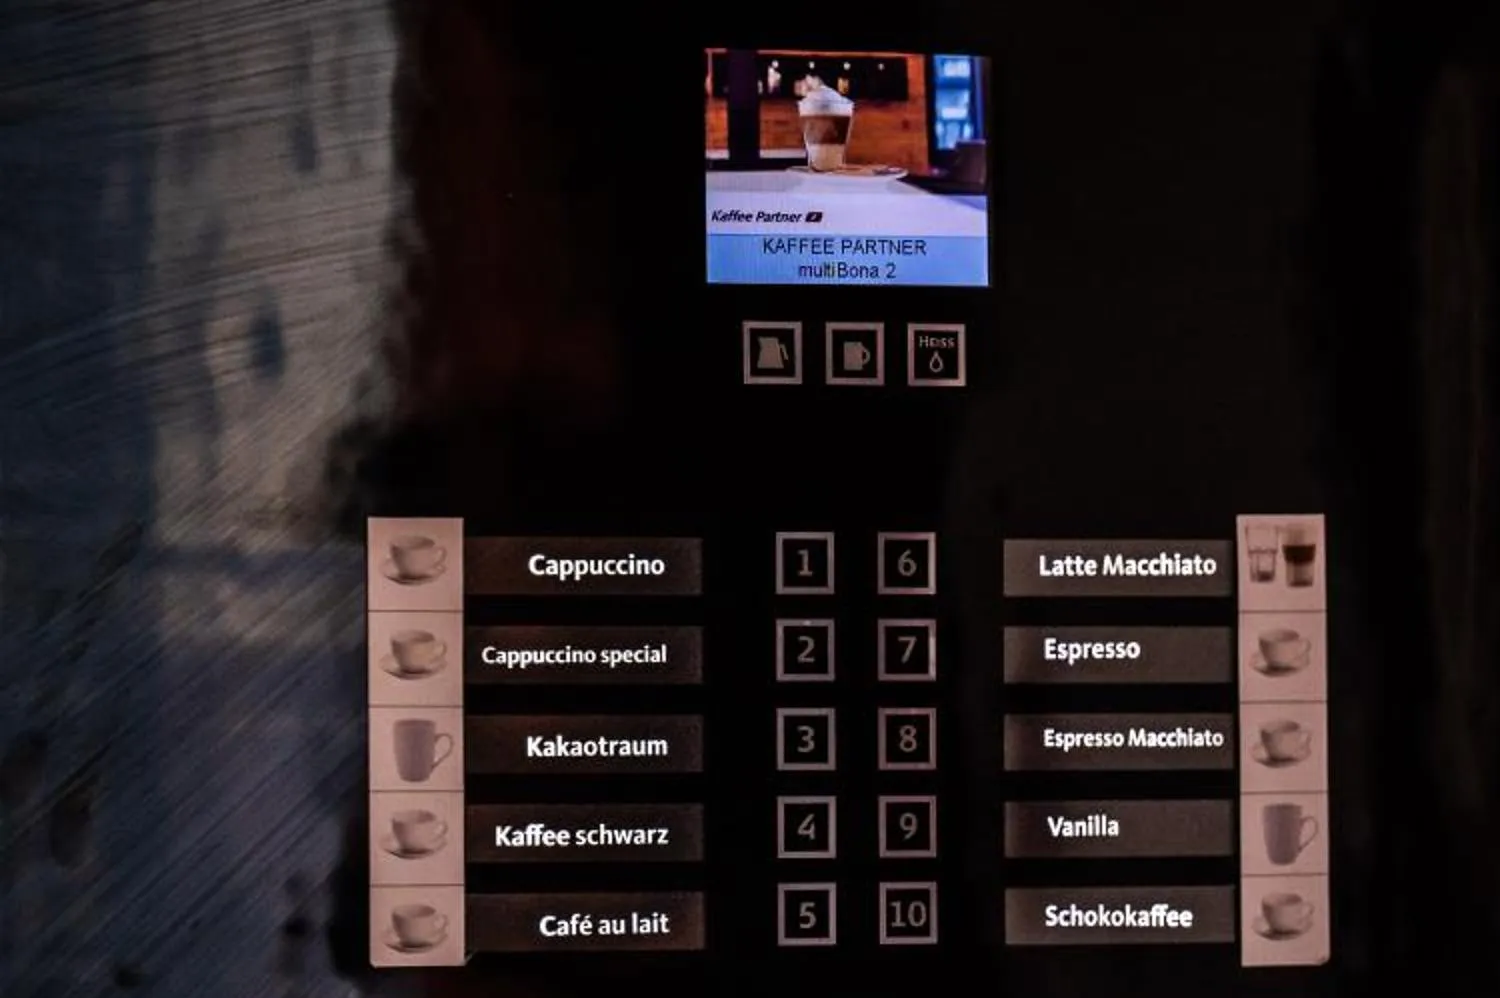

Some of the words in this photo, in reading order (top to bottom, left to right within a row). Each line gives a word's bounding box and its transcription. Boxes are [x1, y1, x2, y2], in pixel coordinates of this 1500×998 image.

[711, 209, 753, 223] Kaffee
[755, 210, 803, 223] Partner
[763, 237, 835, 255] KAFFEE
[841, 238, 927, 256] PARTNER
[885, 261, 897, 279] 2
[528, 553, 665, 581] Cappuccino
[798, 549, 813, 576] 1
[897, 549, 917, 577] 6
[1039, 554, 1098, 577] Latte
[1102, 551, 1217, 577] Macchiato
[481, 645, 597, 669] Cappuccino
[600, 643, 667, 669] special
[797, 635, 815, 663] 2
[898, 635, 917, 663] 7
[1044, 637, 1141, 666] Espresso
[526, 734, 668, 757] Kakaotraum
[797, 725, 815, 753] 3
[899, 724, 918, 753] 8
[1043, 728, 1125, 753] Espresso
[1127, 727, 1224, 748] Macchiato
[495, 823, 571, 847] Kaffee
[575, 823, 669, 846] schwarz
[797, 813, 816, 840] 4
[899, 812, 918, 840] 9
[1047, 813, 1120, 837] Vanilla
[539, 913, 593, 937] Café
[597, 919, 626, 935] au
[631, 911, 670, 934] lait
[799, 901, 817, 929] 5
[890, 900, 927, 928] 10
[1045, 903, 1194, 928] Schokokaffee
